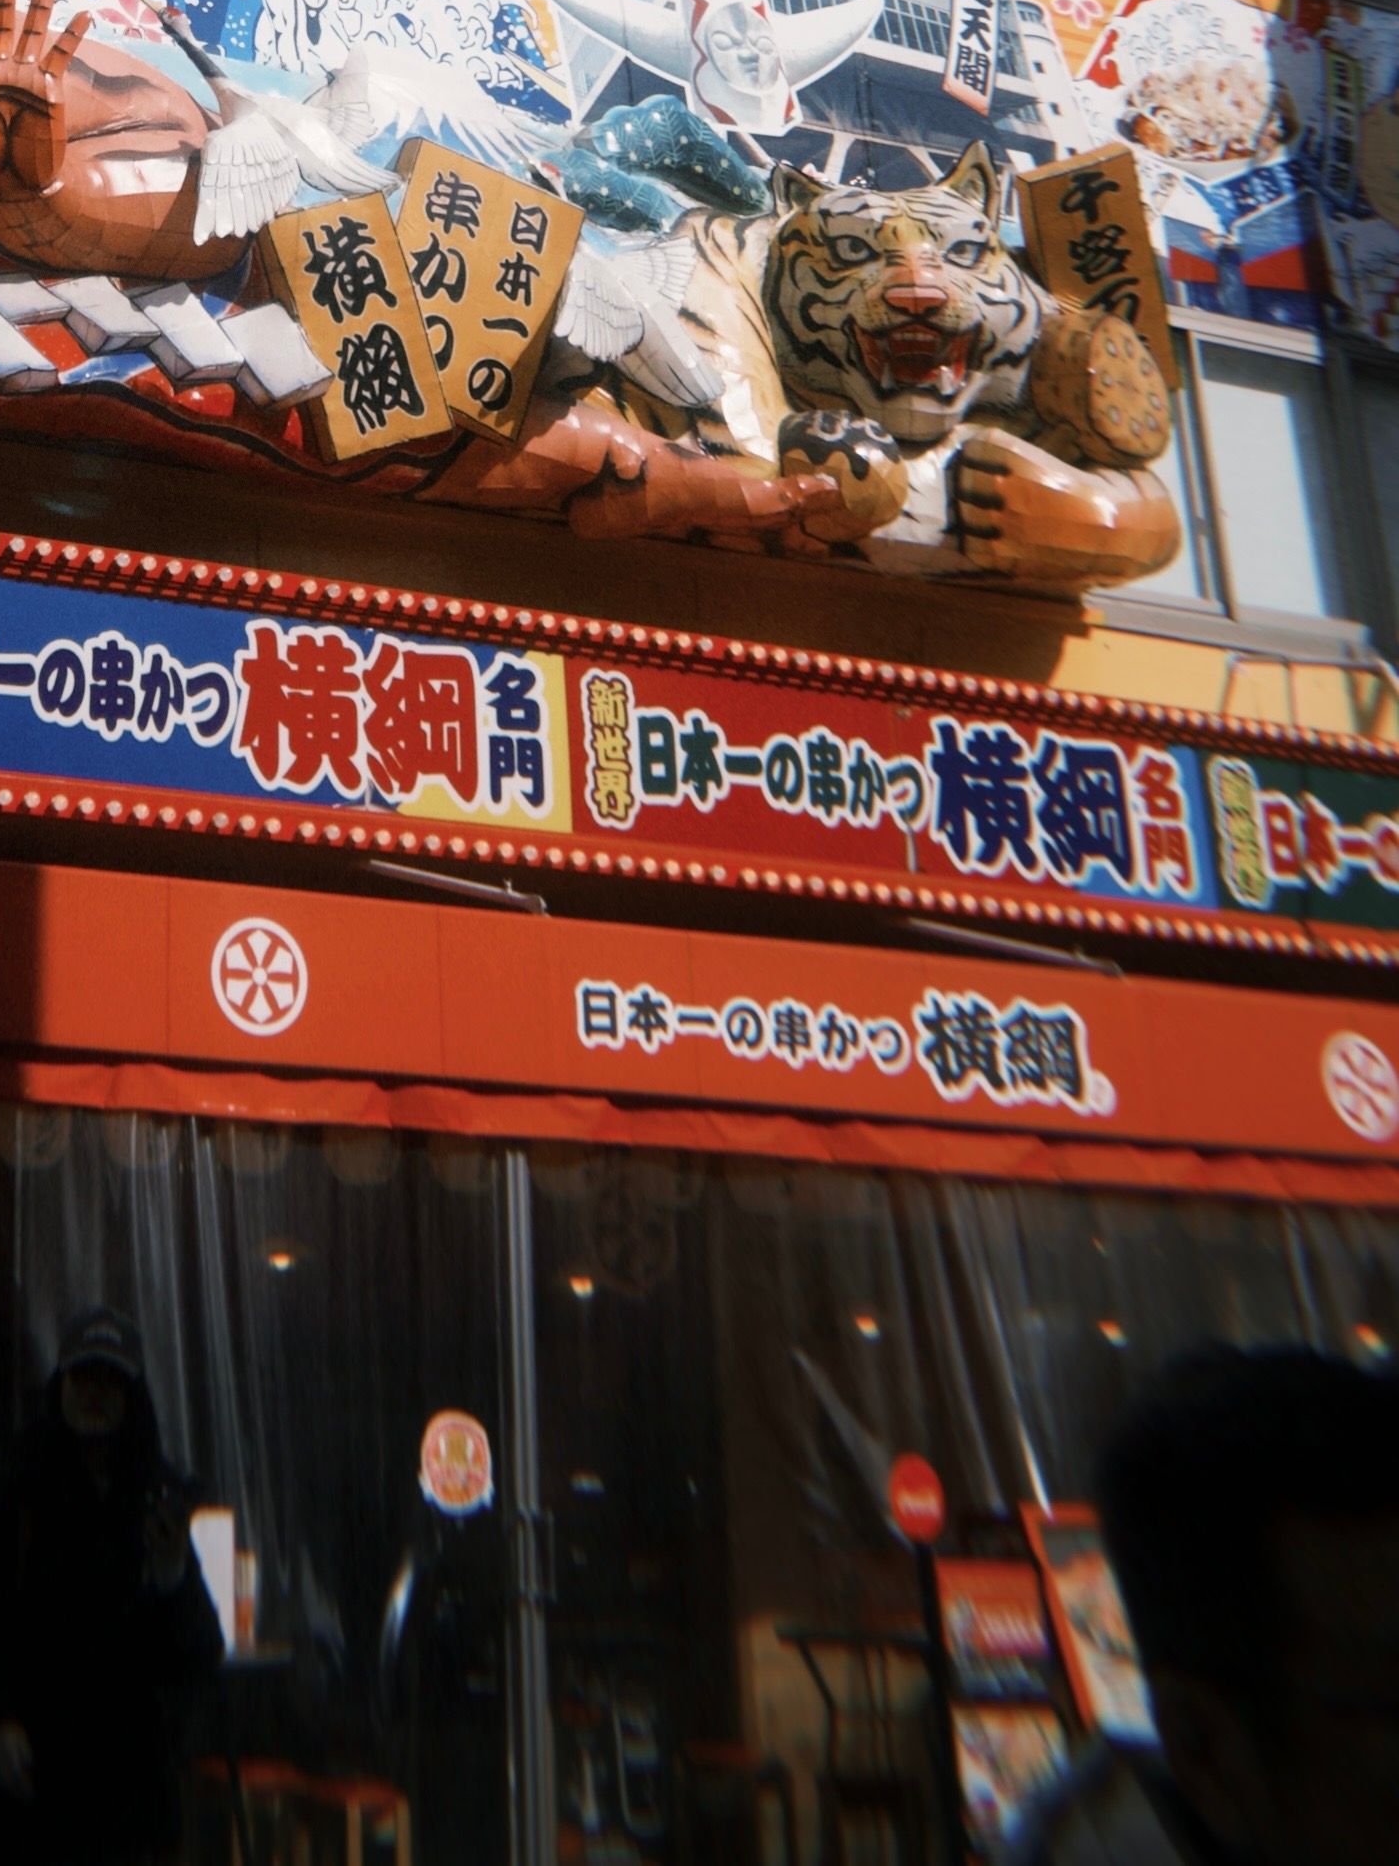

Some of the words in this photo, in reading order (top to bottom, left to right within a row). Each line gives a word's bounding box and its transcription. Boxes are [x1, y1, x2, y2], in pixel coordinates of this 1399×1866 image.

[302, 217, 426, 434] 横綱
[411, 171, 481, 371] 串かつ
[469, 203, 548, 411] 日本一の
[240, 627, 479, 803] 横綱
[486, 661, 544, 809] 名門
[590, 677, 633, 819] 新世界
[638, 717, 926, 824] 日本一の串かつ
[930, 722, 1132, 879] 横綱
[1134, 752, 1192, 886] 名門
[581, 984, 906, 1069] 日本一の串かつ
[920, 995, 1088, 1102] 横綱
